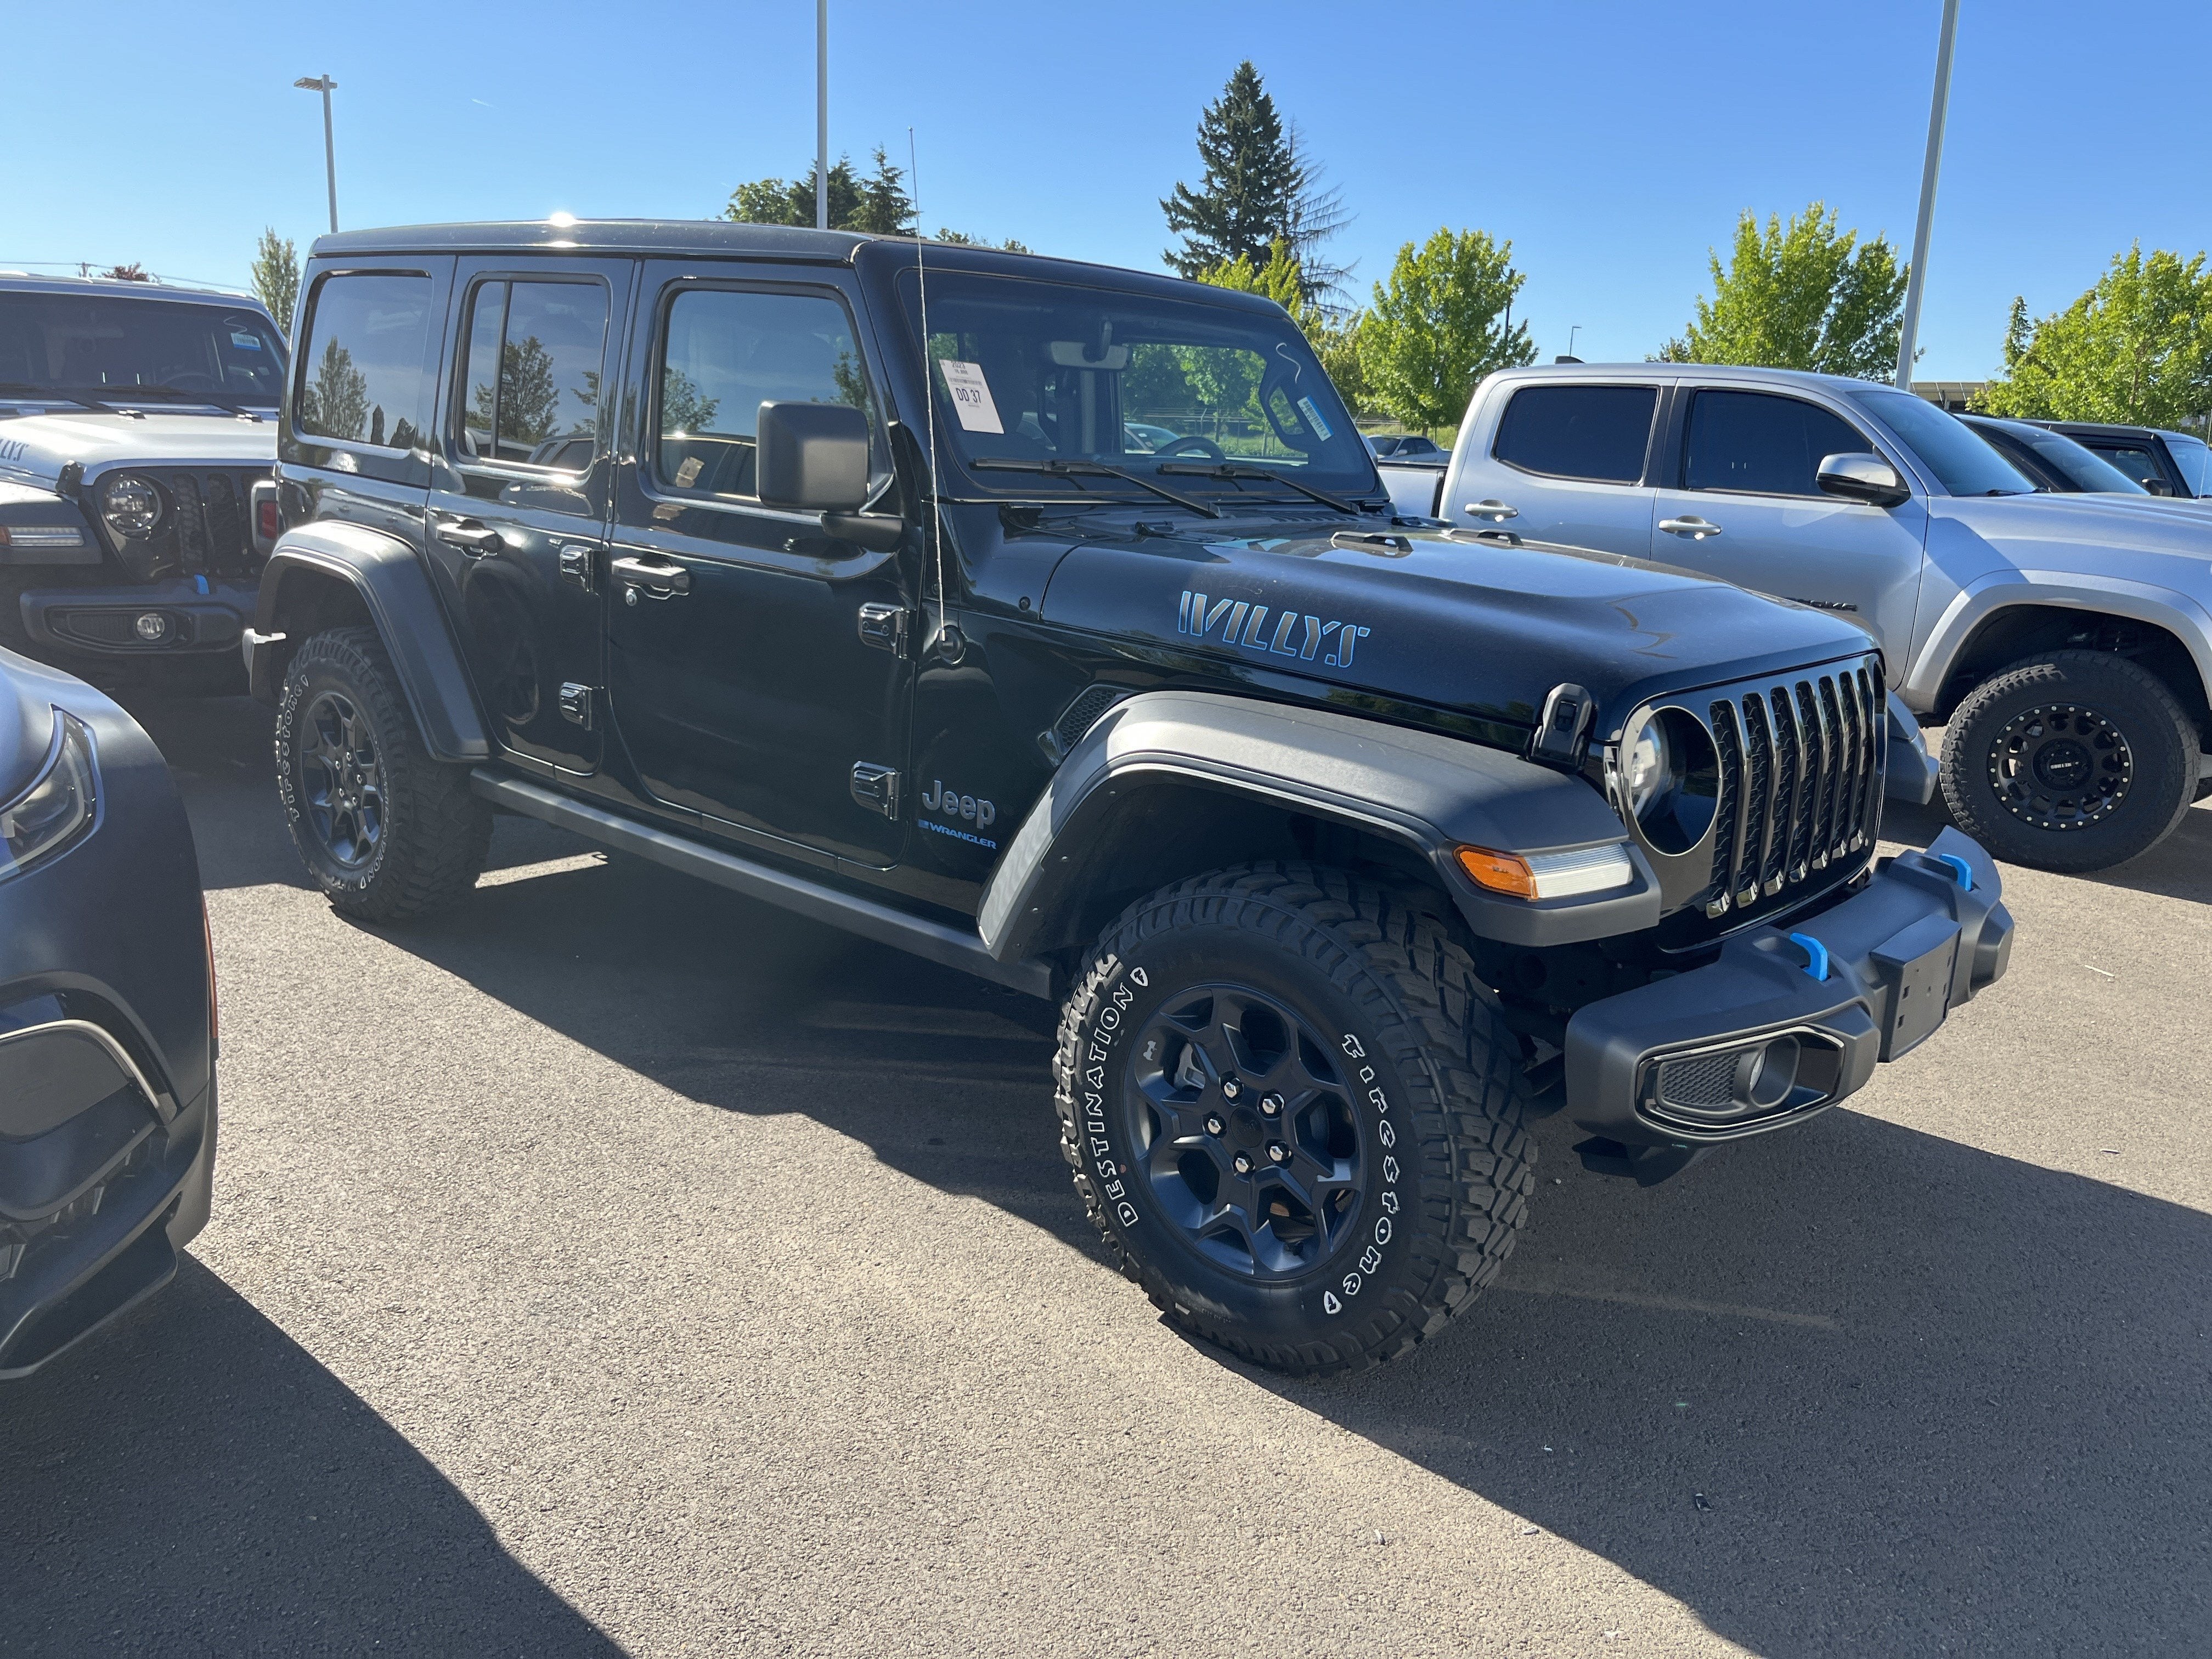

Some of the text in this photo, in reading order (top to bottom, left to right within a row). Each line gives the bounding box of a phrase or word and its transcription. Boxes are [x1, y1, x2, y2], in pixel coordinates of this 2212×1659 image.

[970, 389, 981, 404] 37
[1178, 590, 1371, 668] WILLYS
[922, 780, 996, 830] Jeep
[929, 822, 997, 850] WRANGLER
[1085, 981, 1138, 1227] DESTINATION
